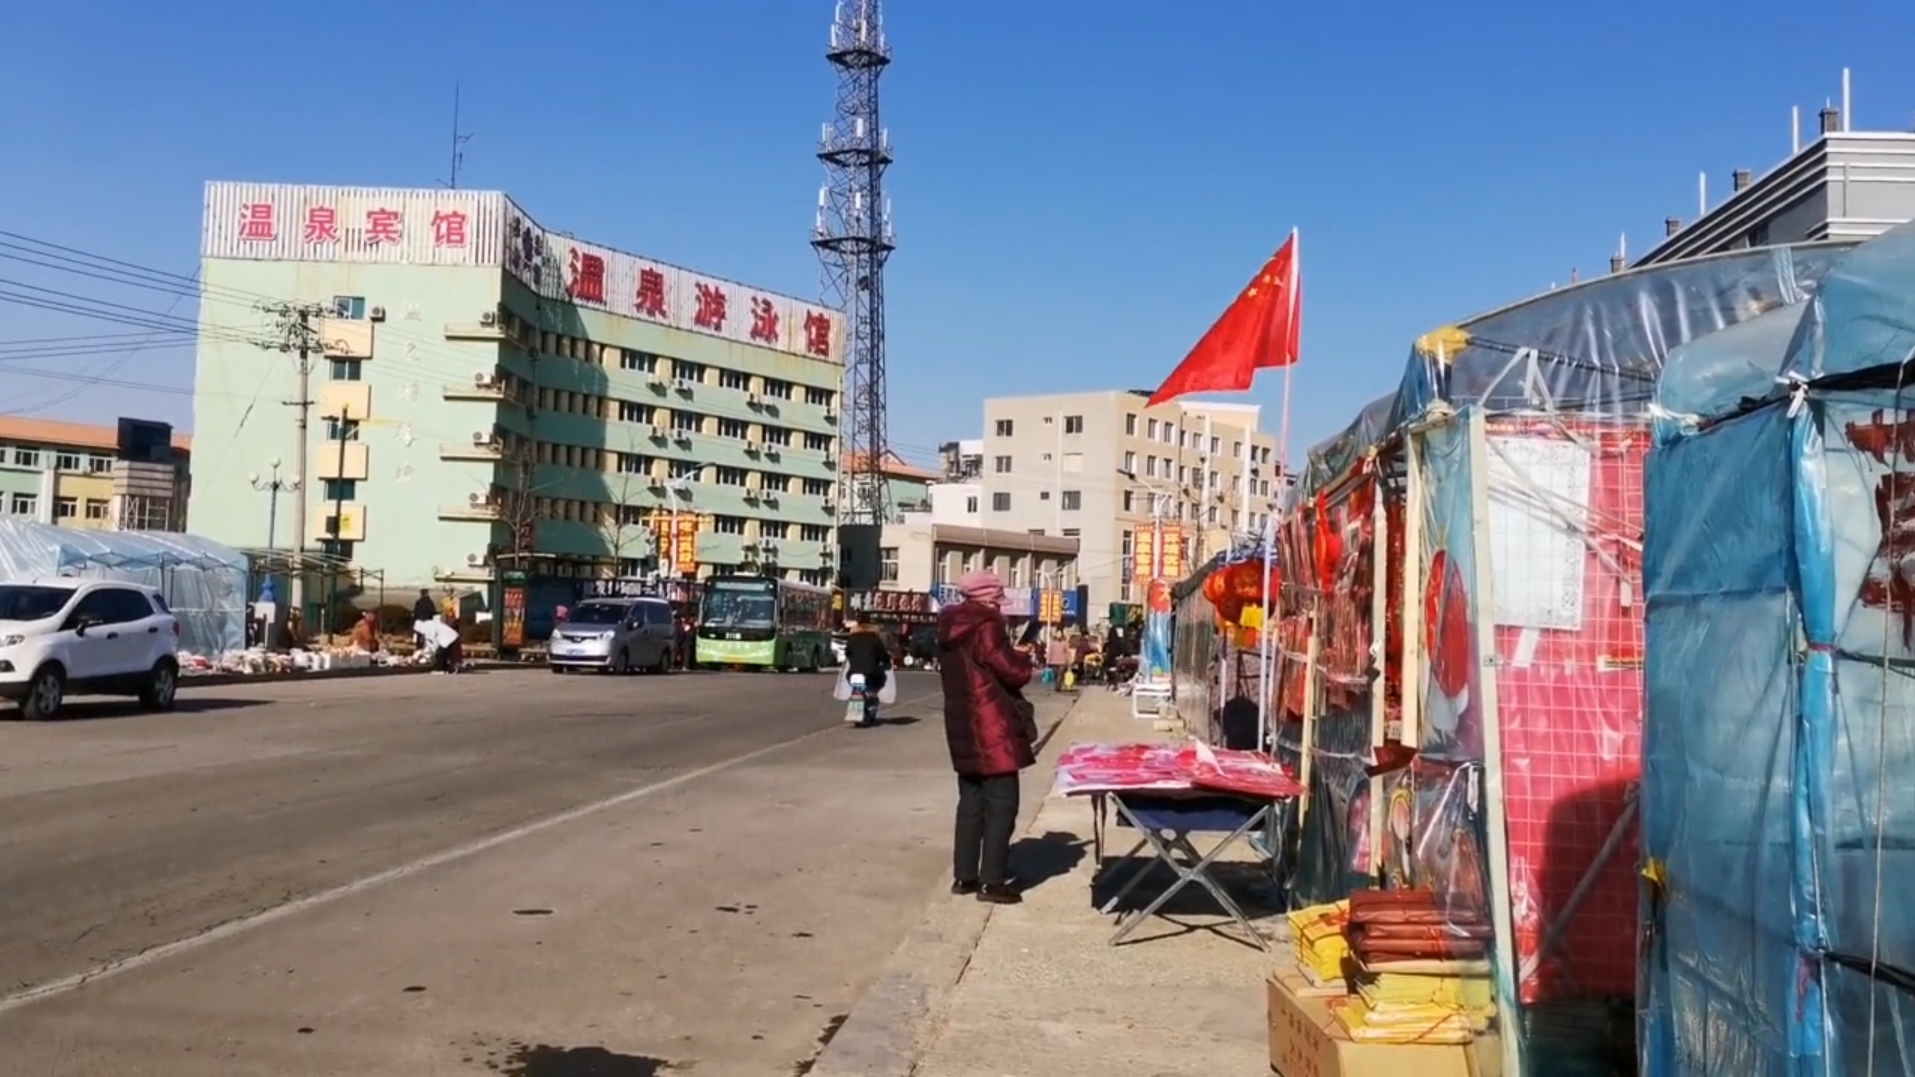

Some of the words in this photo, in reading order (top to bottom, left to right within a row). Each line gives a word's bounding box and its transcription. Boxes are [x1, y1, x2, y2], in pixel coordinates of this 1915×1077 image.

[238, 202, 467, 246] 温泉宾馆
[566, 246, 832, 357] 温泉游泳馆
